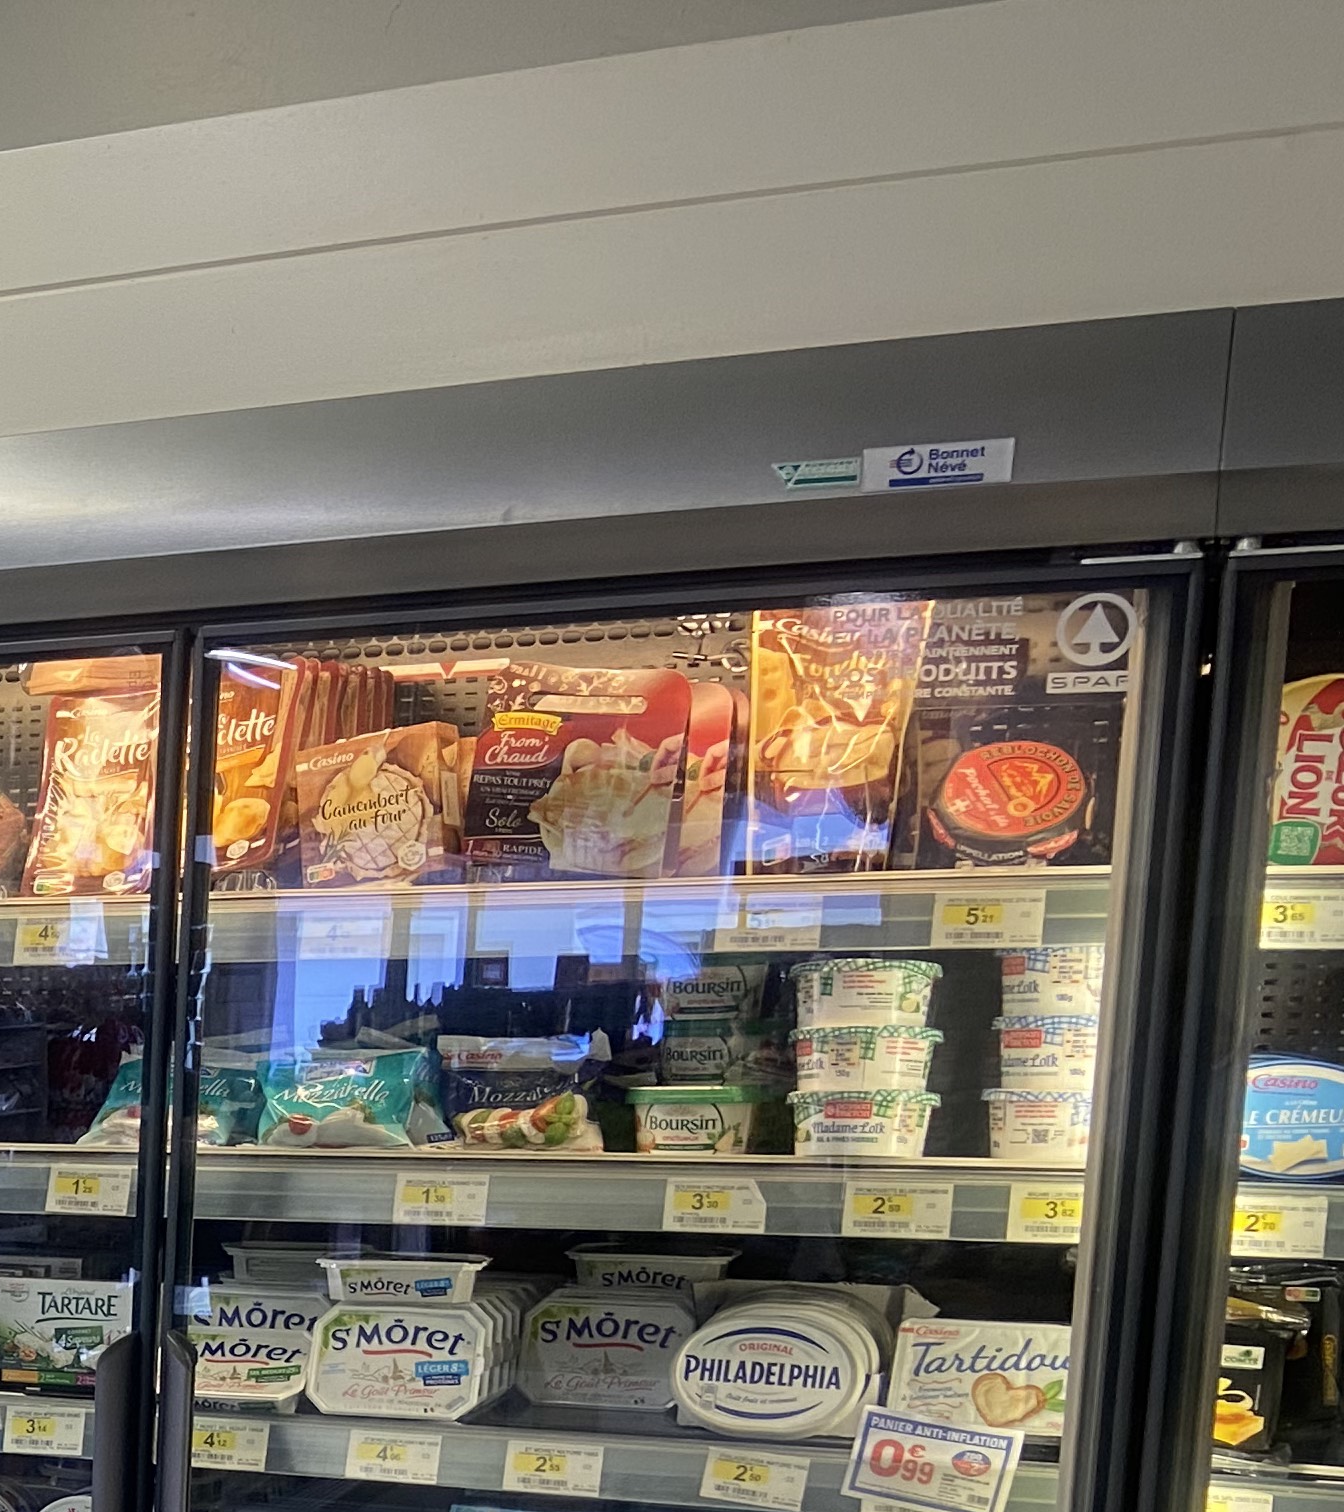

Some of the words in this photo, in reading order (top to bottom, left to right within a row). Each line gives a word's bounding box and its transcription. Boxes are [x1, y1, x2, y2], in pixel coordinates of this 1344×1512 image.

[929, 446, 985, 461] Bonnet
[929, 459, 967, 473] Névé
[834, 608, 890, 622] POUR
[310, 750, 354, 770] Casino
[485, 745, 548, 764] Chaud
[1279, 731, 1334, 819] LION
[320, 790, 411, 822] Camembert
[349, 816, 366, 831] au
[370, 808, 408, 829] four
[486, 807, 522, 828] Solo
[503, 844, 543, 855] RAPIDE
[1252, 1073, 1319, 1091] Casino
[650, 1115, 718, 1134] Boursin
[813, 1122, 857, 1134] Madame
[37, 1291, 119, 1318] TARTARE
[915, 1325, 960, 1337] Casino
[738, 1341, 794, 1356] ORIGINAL
[684, 1354, 841, 1391] PHILADELPHIA
[871, 1417, 913, 1434] PANIER
[915, 1425, 1008, 1449] ANTI-INFLATION
